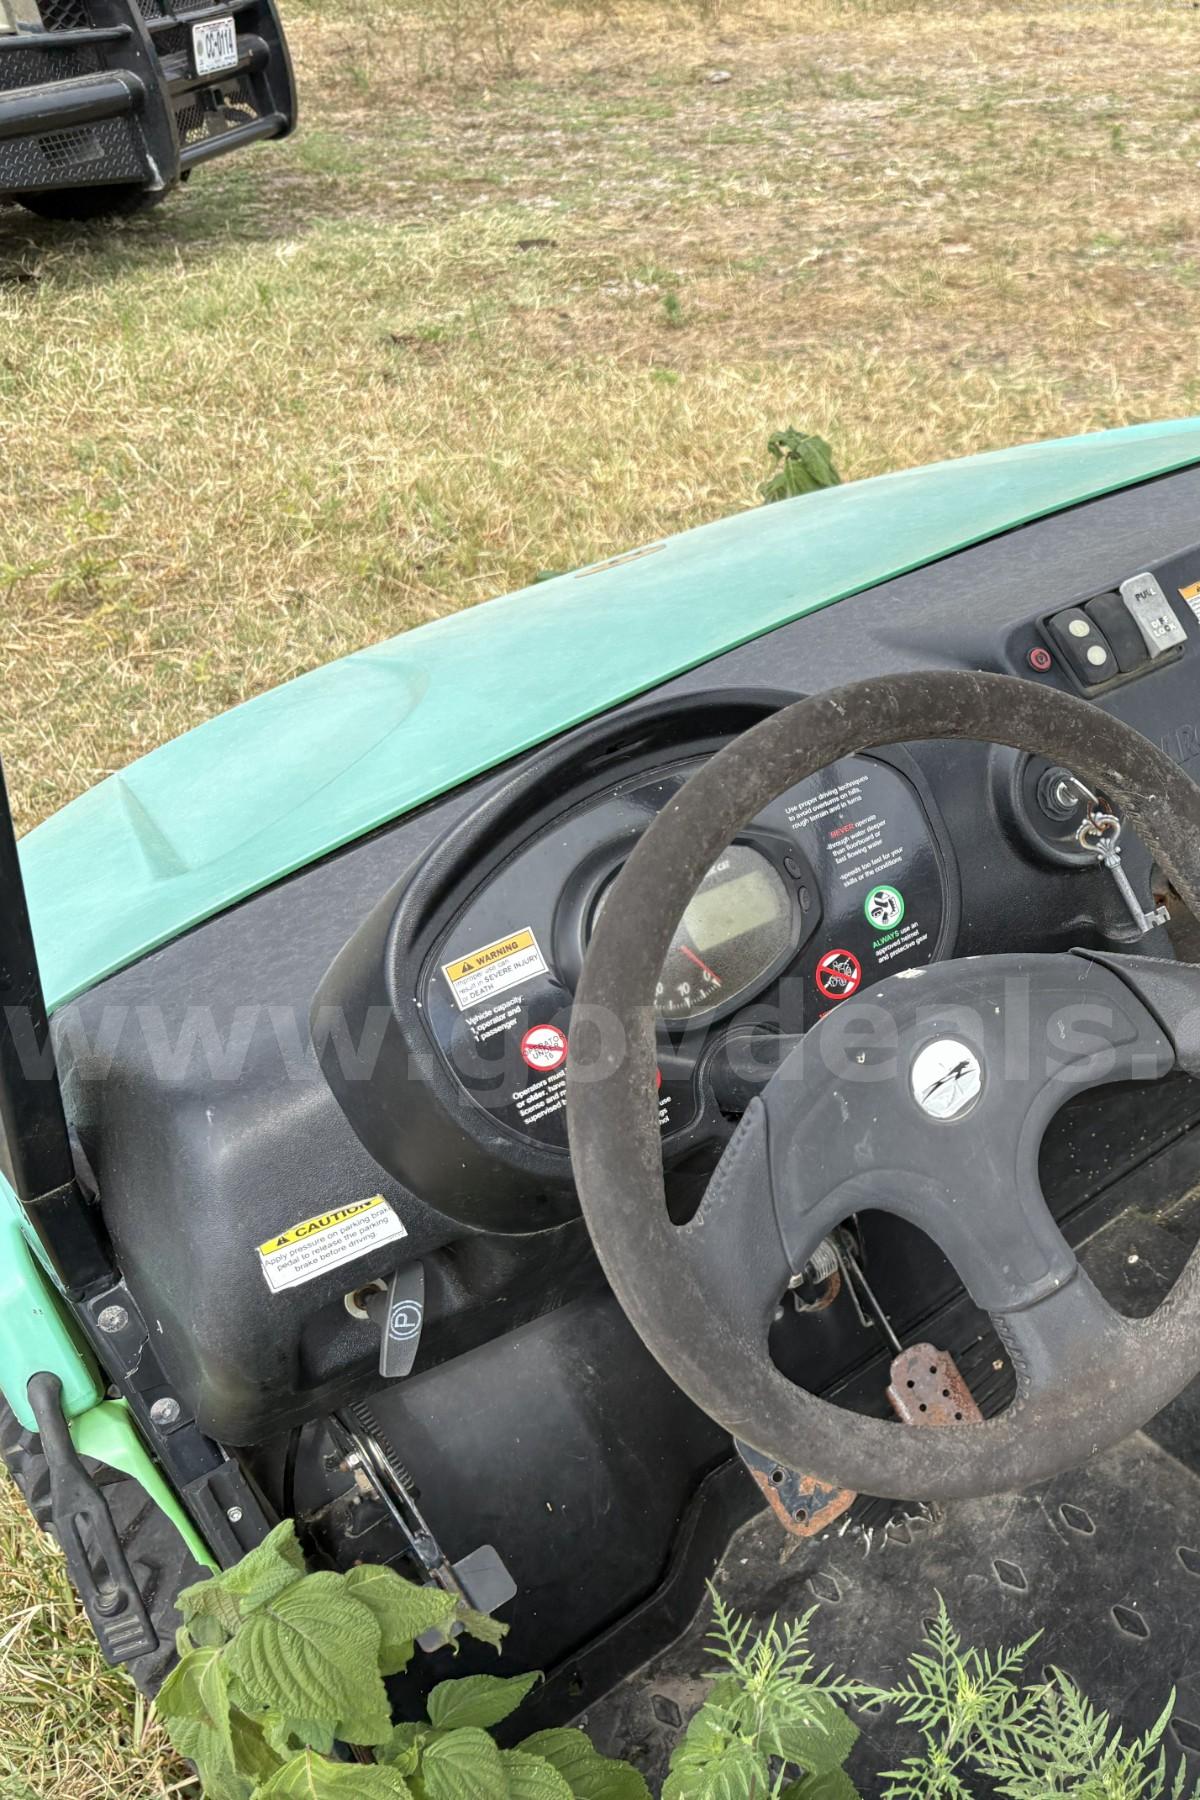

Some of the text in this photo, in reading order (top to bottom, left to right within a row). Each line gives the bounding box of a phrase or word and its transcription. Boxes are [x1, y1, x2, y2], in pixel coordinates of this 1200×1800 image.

[871, 929, 899, 948] ALWAYS
[475, 940, 518, 966] WARNING
[483, 953, 538, 982] SEVERE INJURY
[468, 983, 494, 998] DEATH
[678, 981, 691, 994] 10
[465, 1007, 492, 1026] Vehicle
[506, 1005, 521, 1016] and
[479, 1017, 518, 1040] passenger
[511, 1079, 547, 1101] Operators
[515, 1100, 526, 1109] or
[519, 1100, 545, 1116] license
[544, 1092, 559, 1103] and
[523, 1100, 562, 1125] supervised
[295, 1200, 372, 1237] CAUTION
[264, 1215, 370, 1267] Apply pressure on parking
[276, 1256, 299, 1271] pedal
[300, 1251, 310, 1259] to
[310, 1236, 342, 1255] release
[343, 1230, 357, 1240] the
[358, 1215, 389, 1235] parking
[294, 1256, 318, 1272] brake
[319, 1243, 347, 1260] before
[347, 1230, 376, 1248] driving
